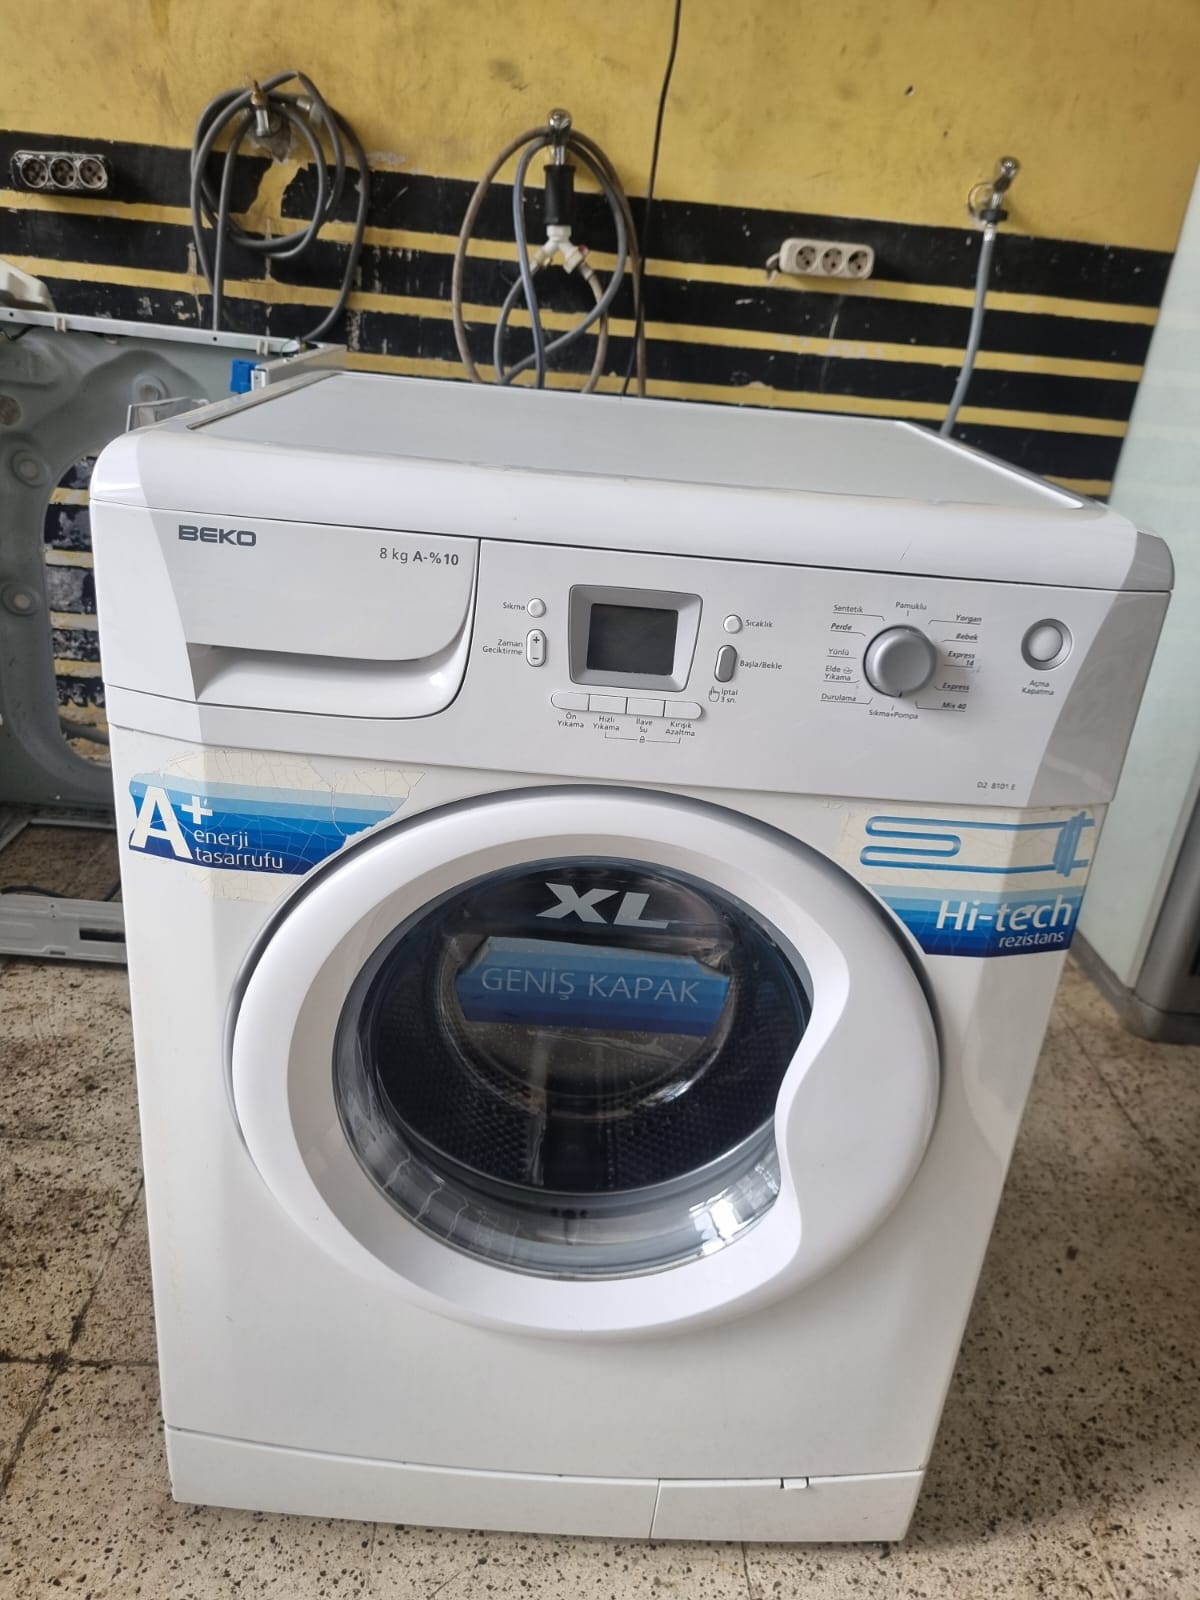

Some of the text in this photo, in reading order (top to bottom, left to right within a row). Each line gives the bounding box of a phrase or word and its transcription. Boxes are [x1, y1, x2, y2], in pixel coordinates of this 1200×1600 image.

[178, 525, 257, 547] BEKO
[379, 547, 388, 560] 8
[392, 548, 408, 564] kg
[833, 604, 864, 614] Sentetik
[895, 601, 927, 611] Pamuklu
[955, 614, 982, 625] Yorgan
[830, 622, 853, 632] Perde
[955, 632, 978, 642] Bebek
[497, 638, 524, 648] Zaman
[482, 645, 524, 656] Geciktirme
[827, 647, 850, 657] Yünlü
[947, 650, 976, 661] Express
[825, 664, 841, 673] Elde
[942, 682, 970, 693] Express
[1029, 679, 1050, 689] Açma
[1021, 686, 1055, 696] Kapatma
[820, 693, 857, 704] Durulama
[941, 701, 956, 711] Mix
[565, 712, 577, 720] Ön
[639, 726, 648, 734] Su
[665, 728, 696, 738] Azaltma
[193, 828, 250, 850] enerji
[195, 847, 284, 870] tasarrufu
[536, 882, 672, 930] XL
[935, 894, 1074, 932] Hi-tech
[998, 930, 1065, 949] rezistans
[481, 966, 701, 1004] GENİŞ KAPAK
